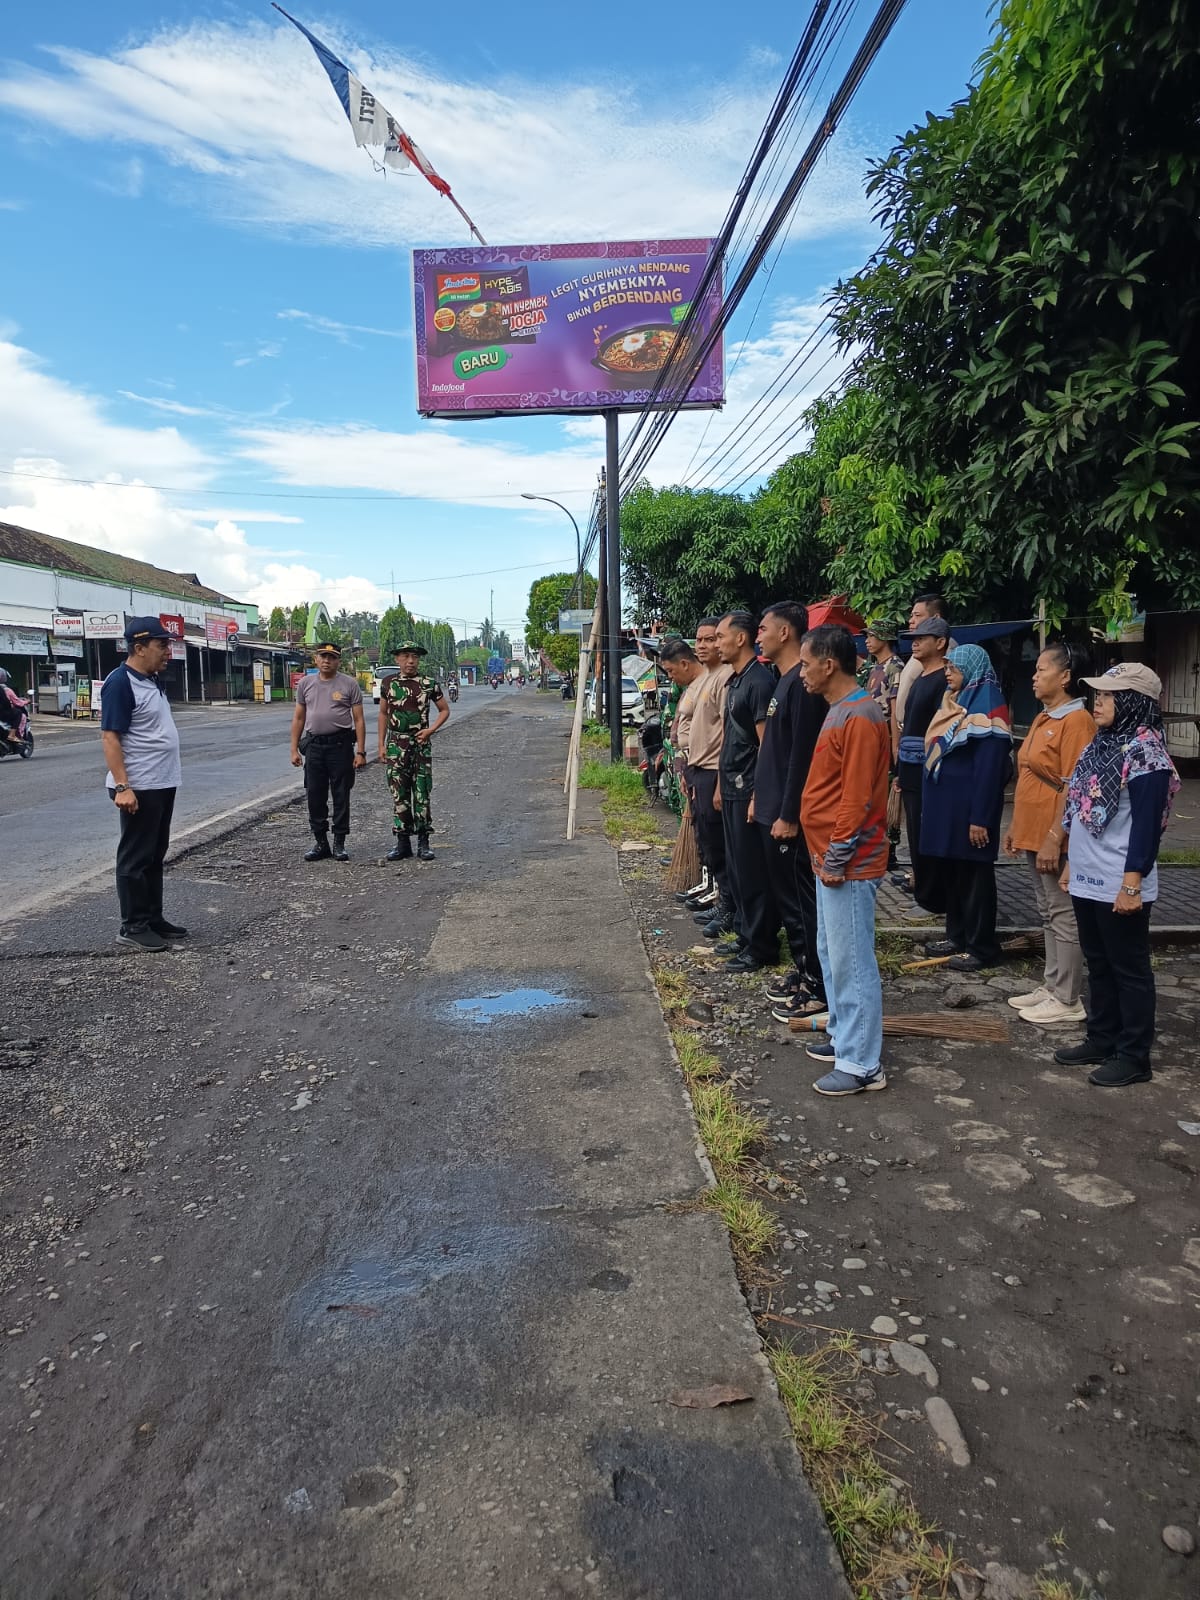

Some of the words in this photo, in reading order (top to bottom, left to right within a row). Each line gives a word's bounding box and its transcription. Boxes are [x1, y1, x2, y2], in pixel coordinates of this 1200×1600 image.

[485, 277, 514, 289] HYPE
[499, 284, 522, 295] ABIS
[551, 279, 578, 298] LEGIT
[581, 265, 636, 285] GURIHNYA
[638, 263, 690, 273] NENDANG
[578, 275, 666, 301] NYEMEKNYA
[566, 306, 591, 322] BIKIN
[593, 288, 682, 312] BERDENDANG
[510, 309, 547, 330] JOGJA
[460, 351, 500, 372] BARU
[432, 383, 465, 392] Indofood
